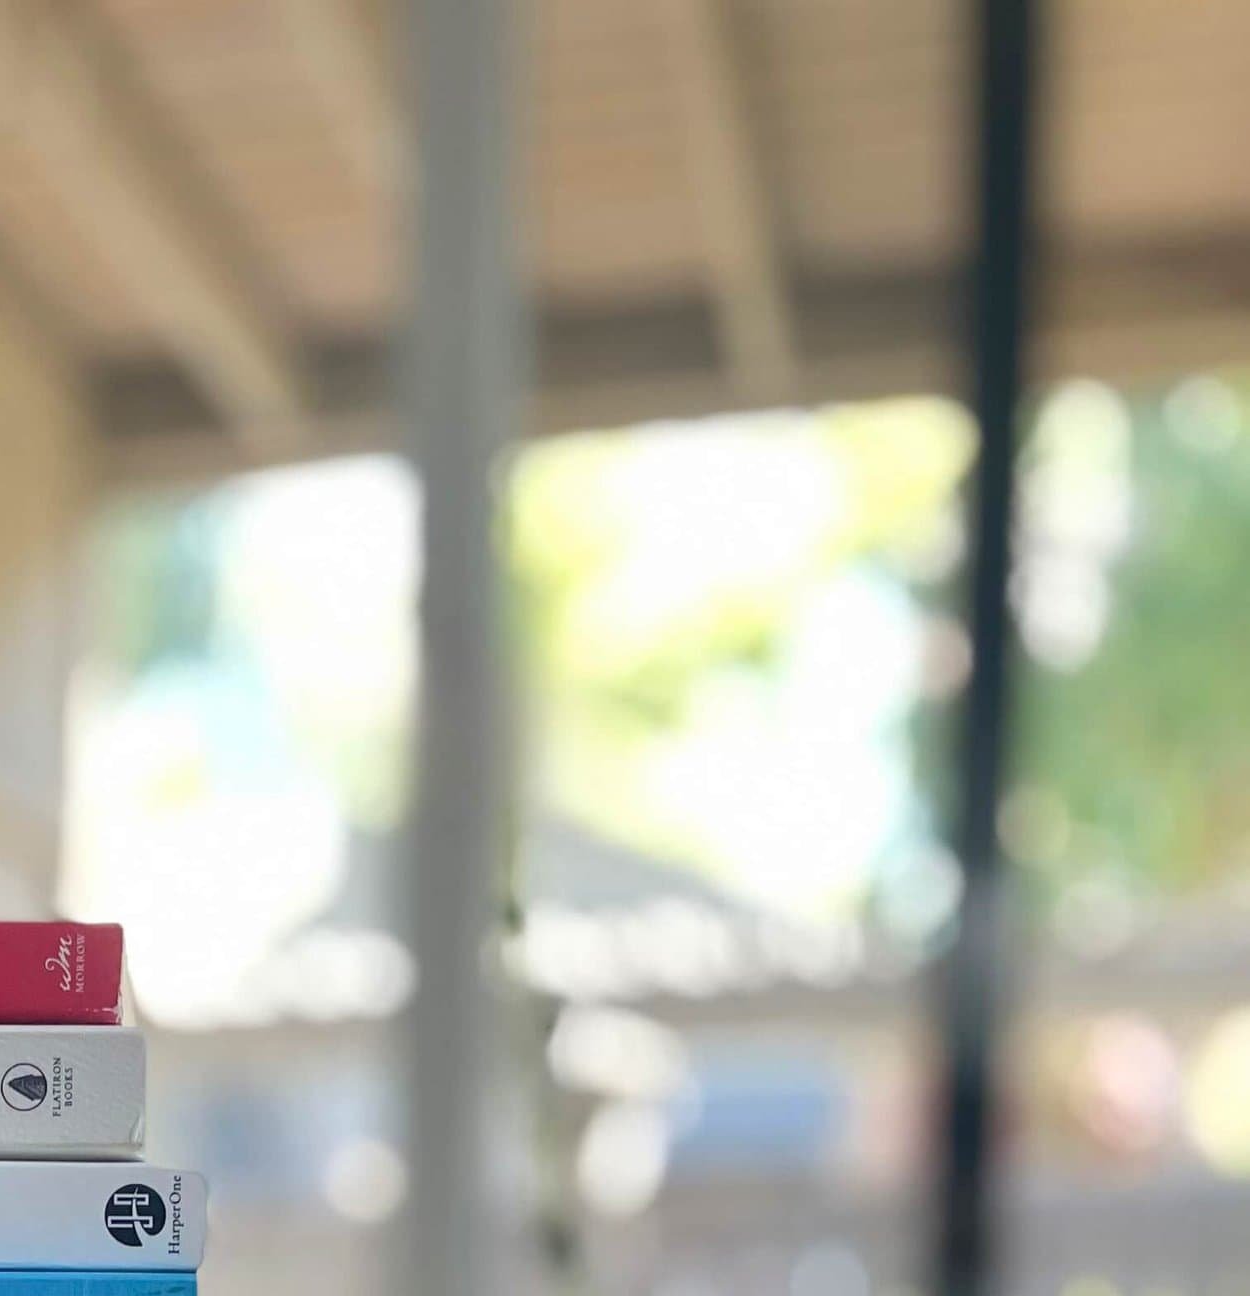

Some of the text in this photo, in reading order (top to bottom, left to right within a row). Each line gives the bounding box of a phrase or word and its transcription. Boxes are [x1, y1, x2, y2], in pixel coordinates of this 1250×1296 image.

[76, 933, 86, 993] MORROW
[53, 1057, 61, 1117] FLATIRON
[65, 1067, 73, 1106] BOOKS
[168, 1175, 184, 1254] HarperOne
